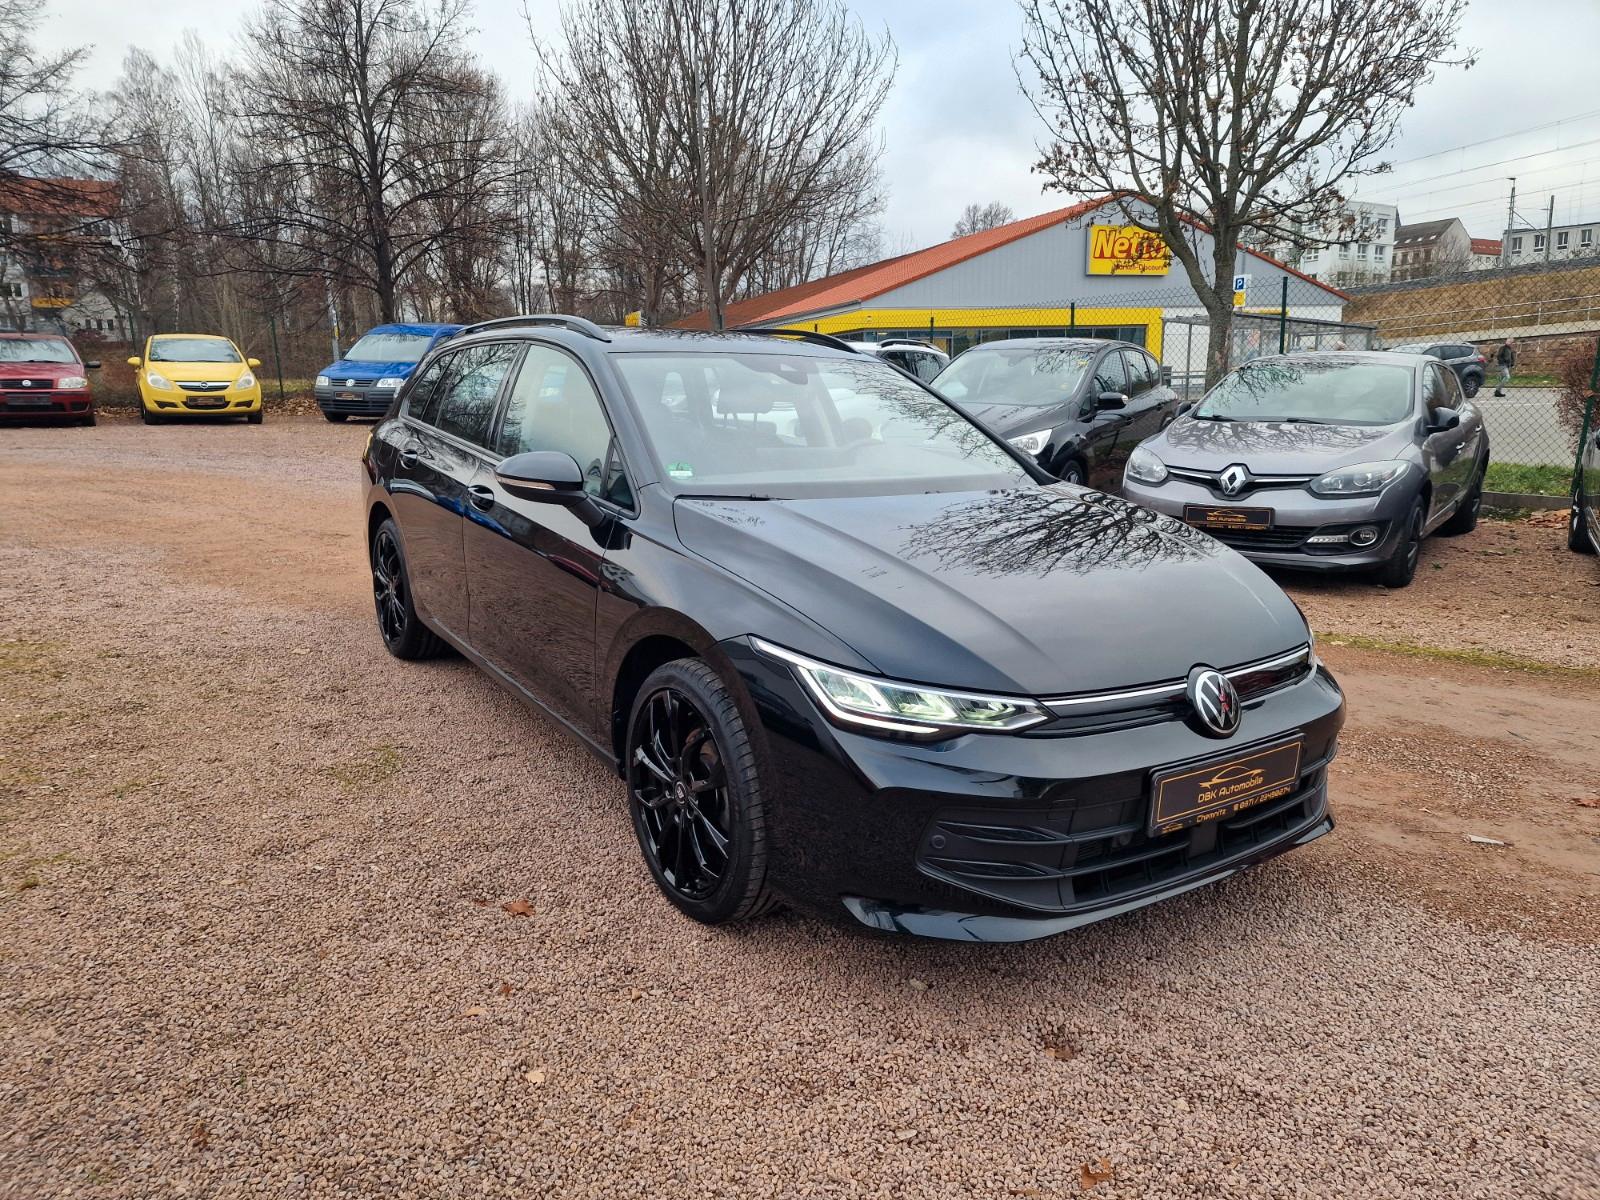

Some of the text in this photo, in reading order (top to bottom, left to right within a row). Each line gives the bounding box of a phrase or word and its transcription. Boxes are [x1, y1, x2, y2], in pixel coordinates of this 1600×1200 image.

[1236, 279, 1243, 289] P
[1198, 776, 1264, 803] DBK Automobile
[1196, 809, 1226, 823] Chemnitz
